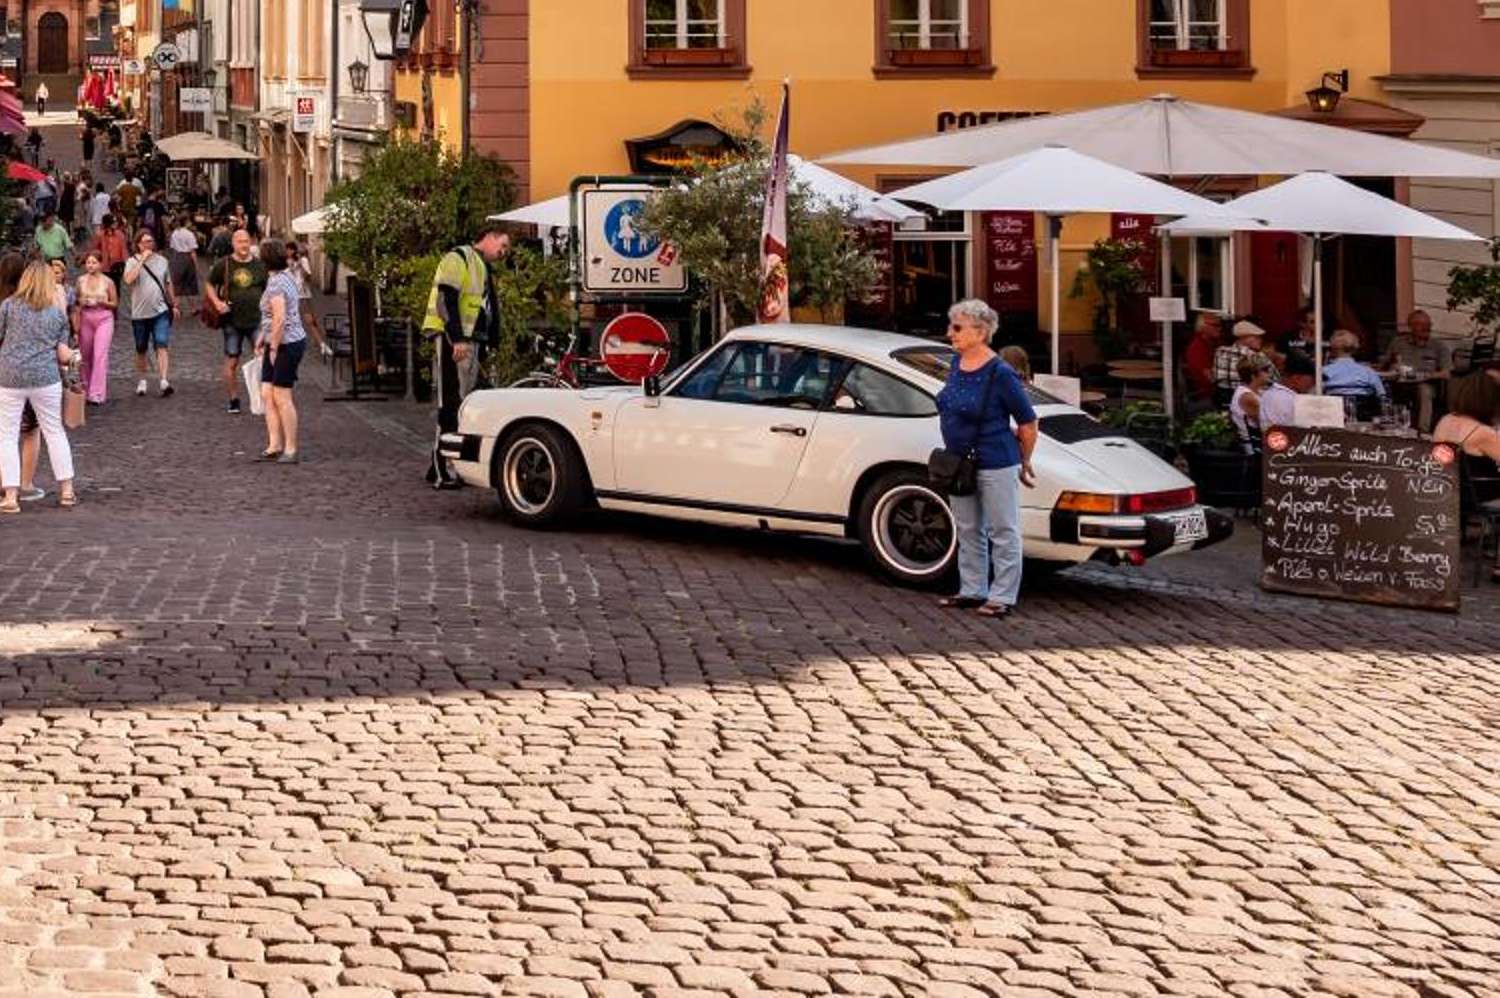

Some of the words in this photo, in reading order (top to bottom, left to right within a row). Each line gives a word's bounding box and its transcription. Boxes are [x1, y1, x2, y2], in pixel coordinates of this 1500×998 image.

[611, 267, 660, 283] ZONE
[1287, 432, 1342, 458] Alles
[1350, 445, 1388, 463] auch
[1284, 516, 1340, 543] Hugo
[1345, 540, 1393, 562] Wild
[1399, 545, 1451, 576] Berry
